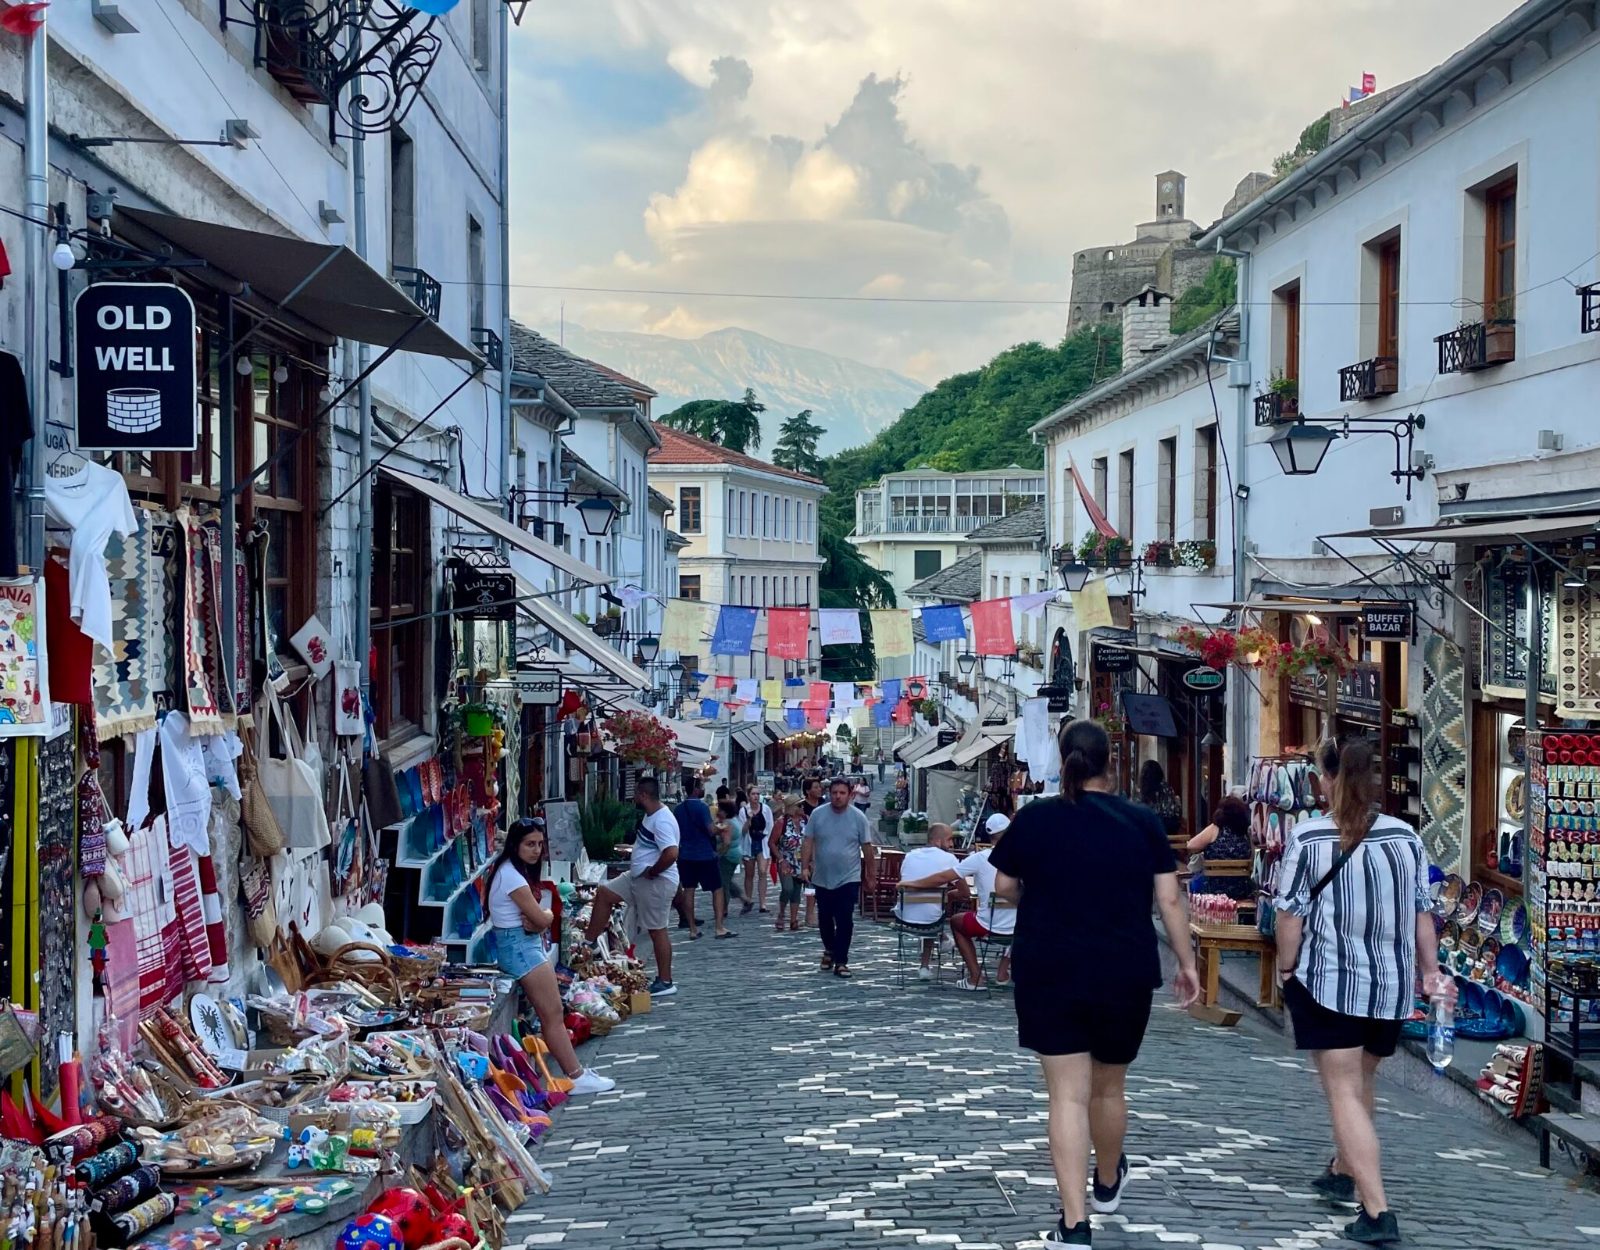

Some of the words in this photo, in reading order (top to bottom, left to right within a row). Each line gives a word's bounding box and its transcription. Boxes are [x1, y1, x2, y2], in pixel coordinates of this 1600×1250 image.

[97, 305, 171, 330] OLD
[95, 346, 175, 371] WELL
[46, 434, 65, 451] UGA
[1367, 613, 1405, 623] BUFFET
[1369, 623, 1401, 632] BAZAR
